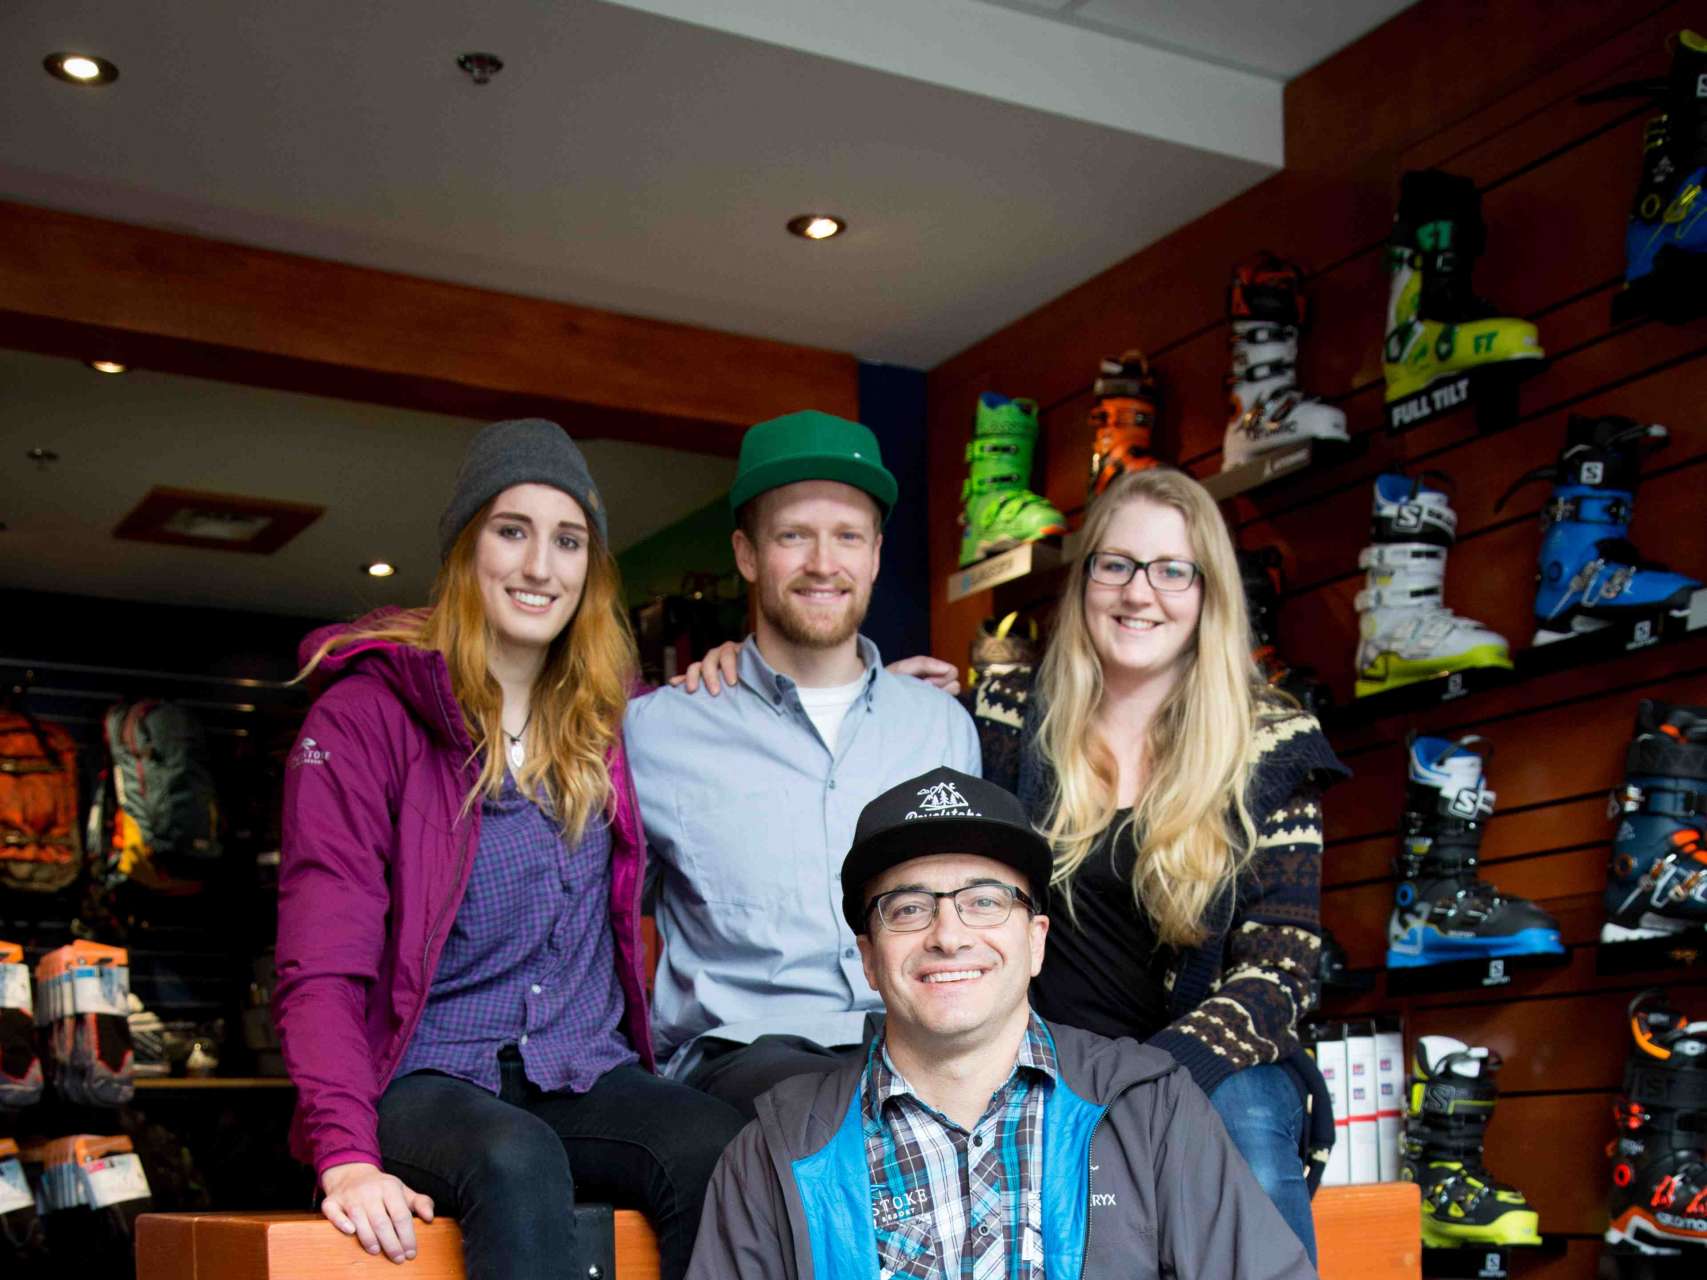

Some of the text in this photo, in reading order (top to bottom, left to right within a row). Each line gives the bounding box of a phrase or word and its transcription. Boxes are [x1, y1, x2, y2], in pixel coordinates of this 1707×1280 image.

[1391, 377, 1470, 428] FULL TILT
[1090, 1194, 1116, 1207] RYX
